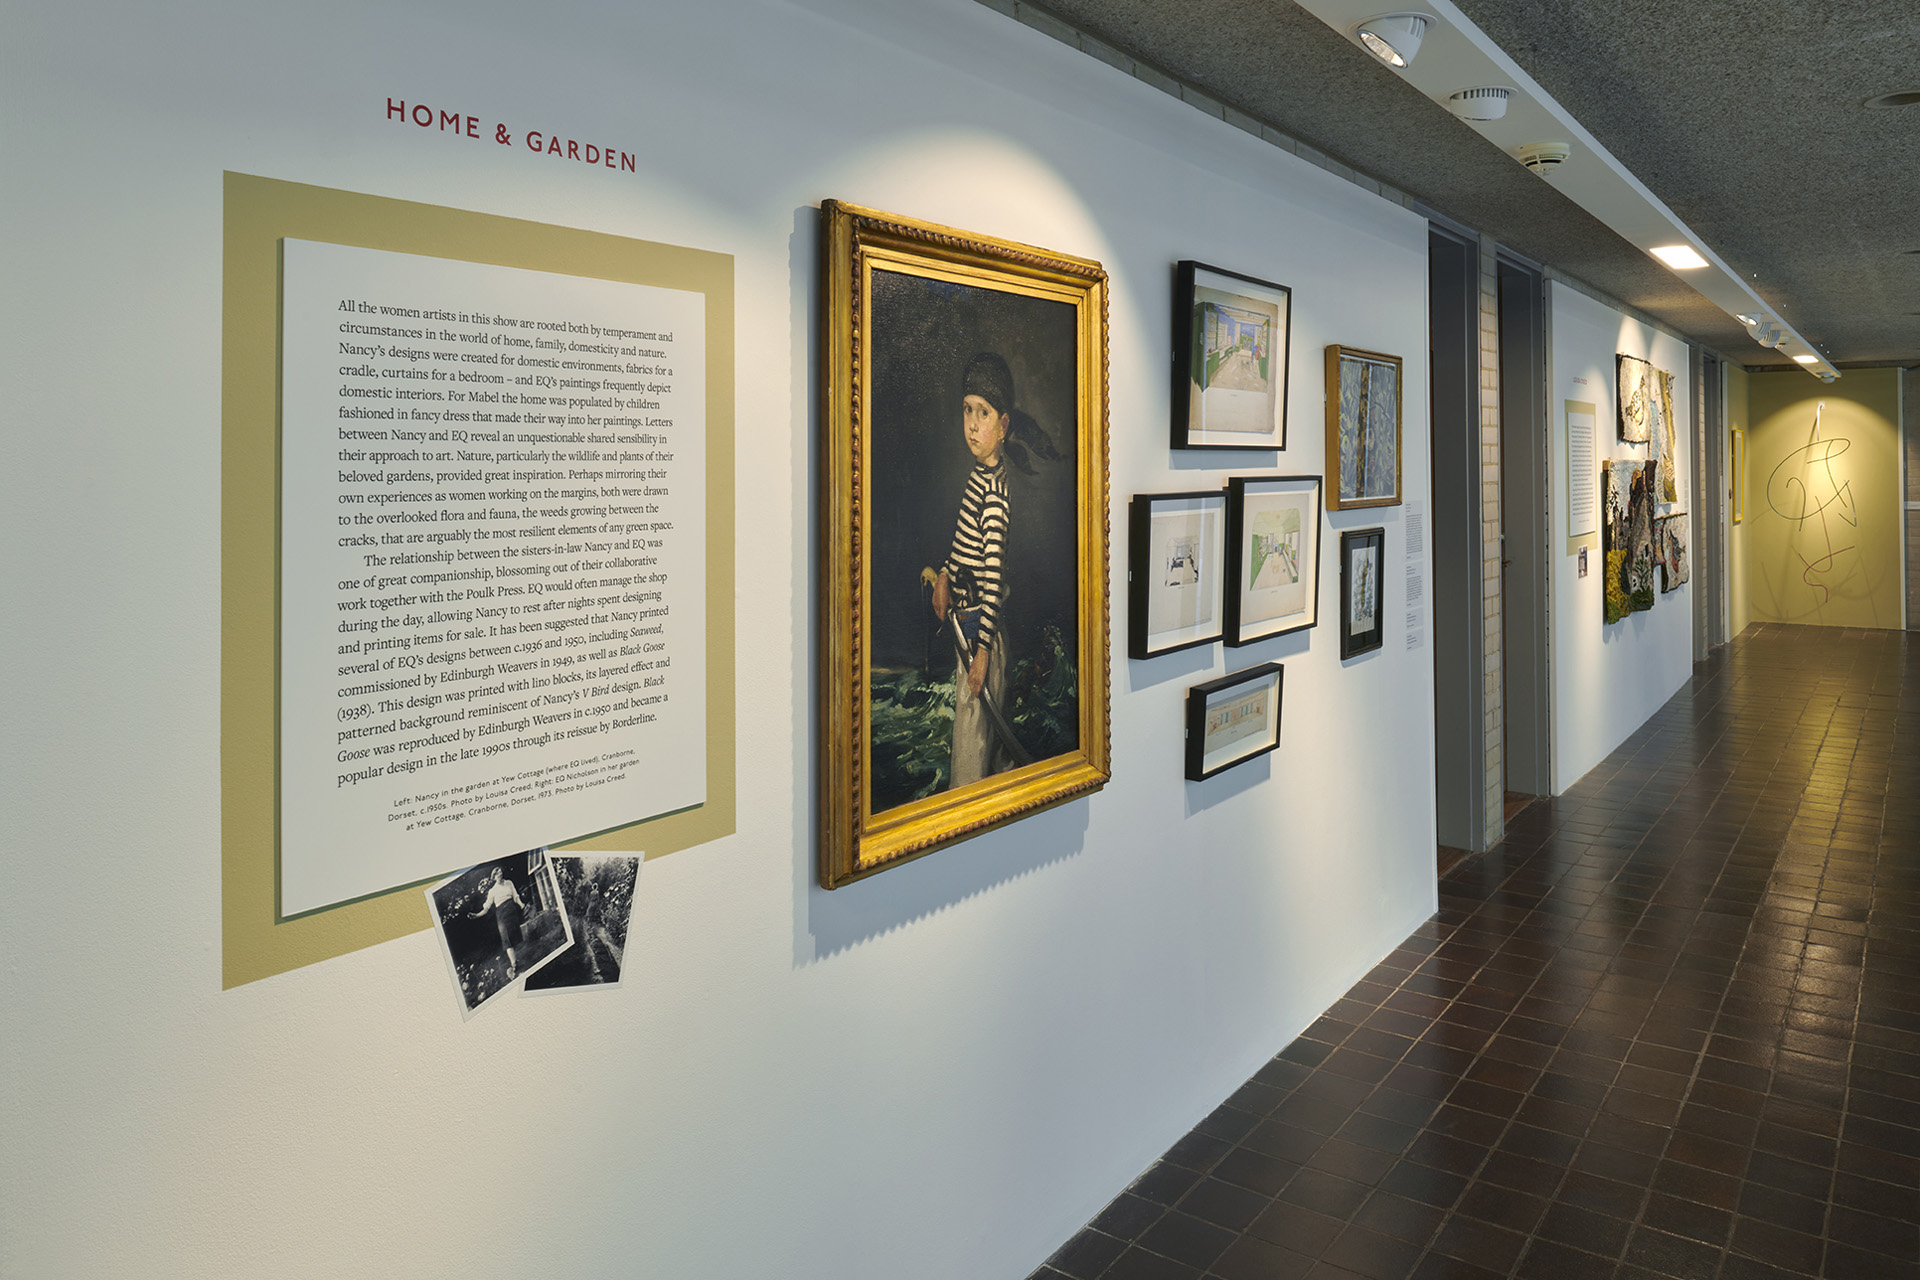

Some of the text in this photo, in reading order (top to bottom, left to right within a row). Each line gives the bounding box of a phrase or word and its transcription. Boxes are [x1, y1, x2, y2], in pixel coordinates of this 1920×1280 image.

[387, 97, 636, 173] HOME & GARDEN
[338, 299, 673, 342] All the women artists in this show are rooted both by temperament and
[338, 342, 673, 376] Nancy’s designs were created for domestic environments, fabrics for a
[338, 384, 660, 411] domestic interiors. For Mabel the home was populated by children
[338, 427, 667, 447] between Nancy and EQ reveal an unquestionable shared sensibility in
[338, 467, 667, 485] beloved gardens, provided great inspiration. Perhaps mirroring their
[338, 502, 659, 526] to the overlooked flora and fauna, the weeds growing between the
[363, 538, 663, 567] The relationship between the sisters-in-law Nancy and EQ was
[337, 571, 668, 612] work together with the Poulk Press. EQ would often manage the shop
[337, 623, 664, 676] several of EQ’s designs between c.1936 and 1950, including Seaweed,
[337, 674, 665, 745] patterned background reminiscent of Nancy’s V Bird design. Black
[337, 712, 657, 788] popular design in the late 1990s through its reissue by Borderline.
[414, 792, 440, 802] Nancy
[450, 786, 463, 795] the
[465, 780, 490, 794] garden
[517, 768, 544, 780] Cottage
[569, 759, 580, 768] EQ
[450, 797, 473, 808] Photo
[474, 794, 484, 803] by
[485, 789, 508, 800] Louisa
[555, 774, 565, 784] EQ
[566, 768, 599, 780] Nicholson
[618, 759, 639, 770] garden
[416, 820, 432, 828] Yew
[554, 785, 575, 795] Photo
[584, 778, 605, 788] Louisa
